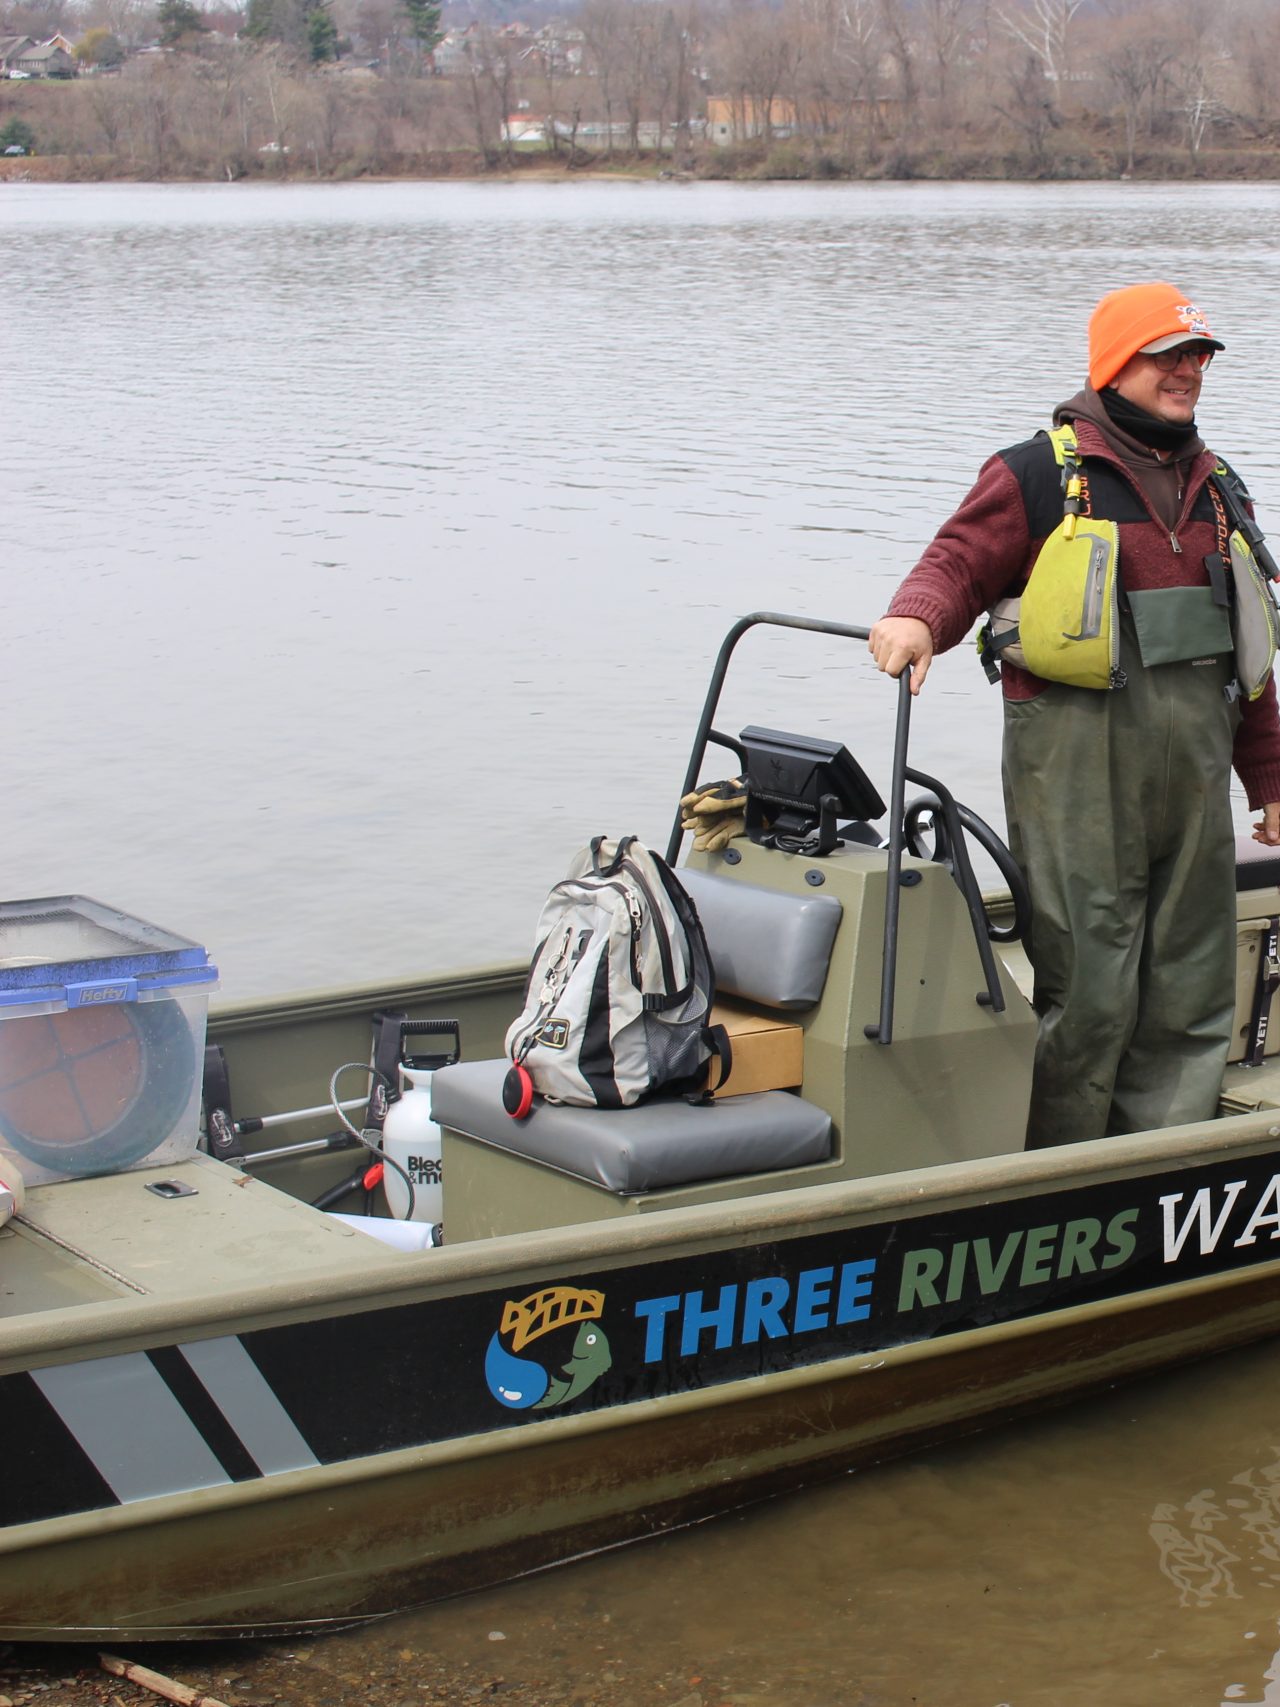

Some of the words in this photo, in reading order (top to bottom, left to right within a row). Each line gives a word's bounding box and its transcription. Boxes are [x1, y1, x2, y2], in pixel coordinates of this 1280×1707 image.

[1268, 936, 1278, 957] ETI
[81, 986, 124, 1002] Hefty
[1256, 1016, 1268, 1047] YETI
[635, 1259, 877, 1363] THREE
[897, 1208, 1140, 1311] RIVERS
